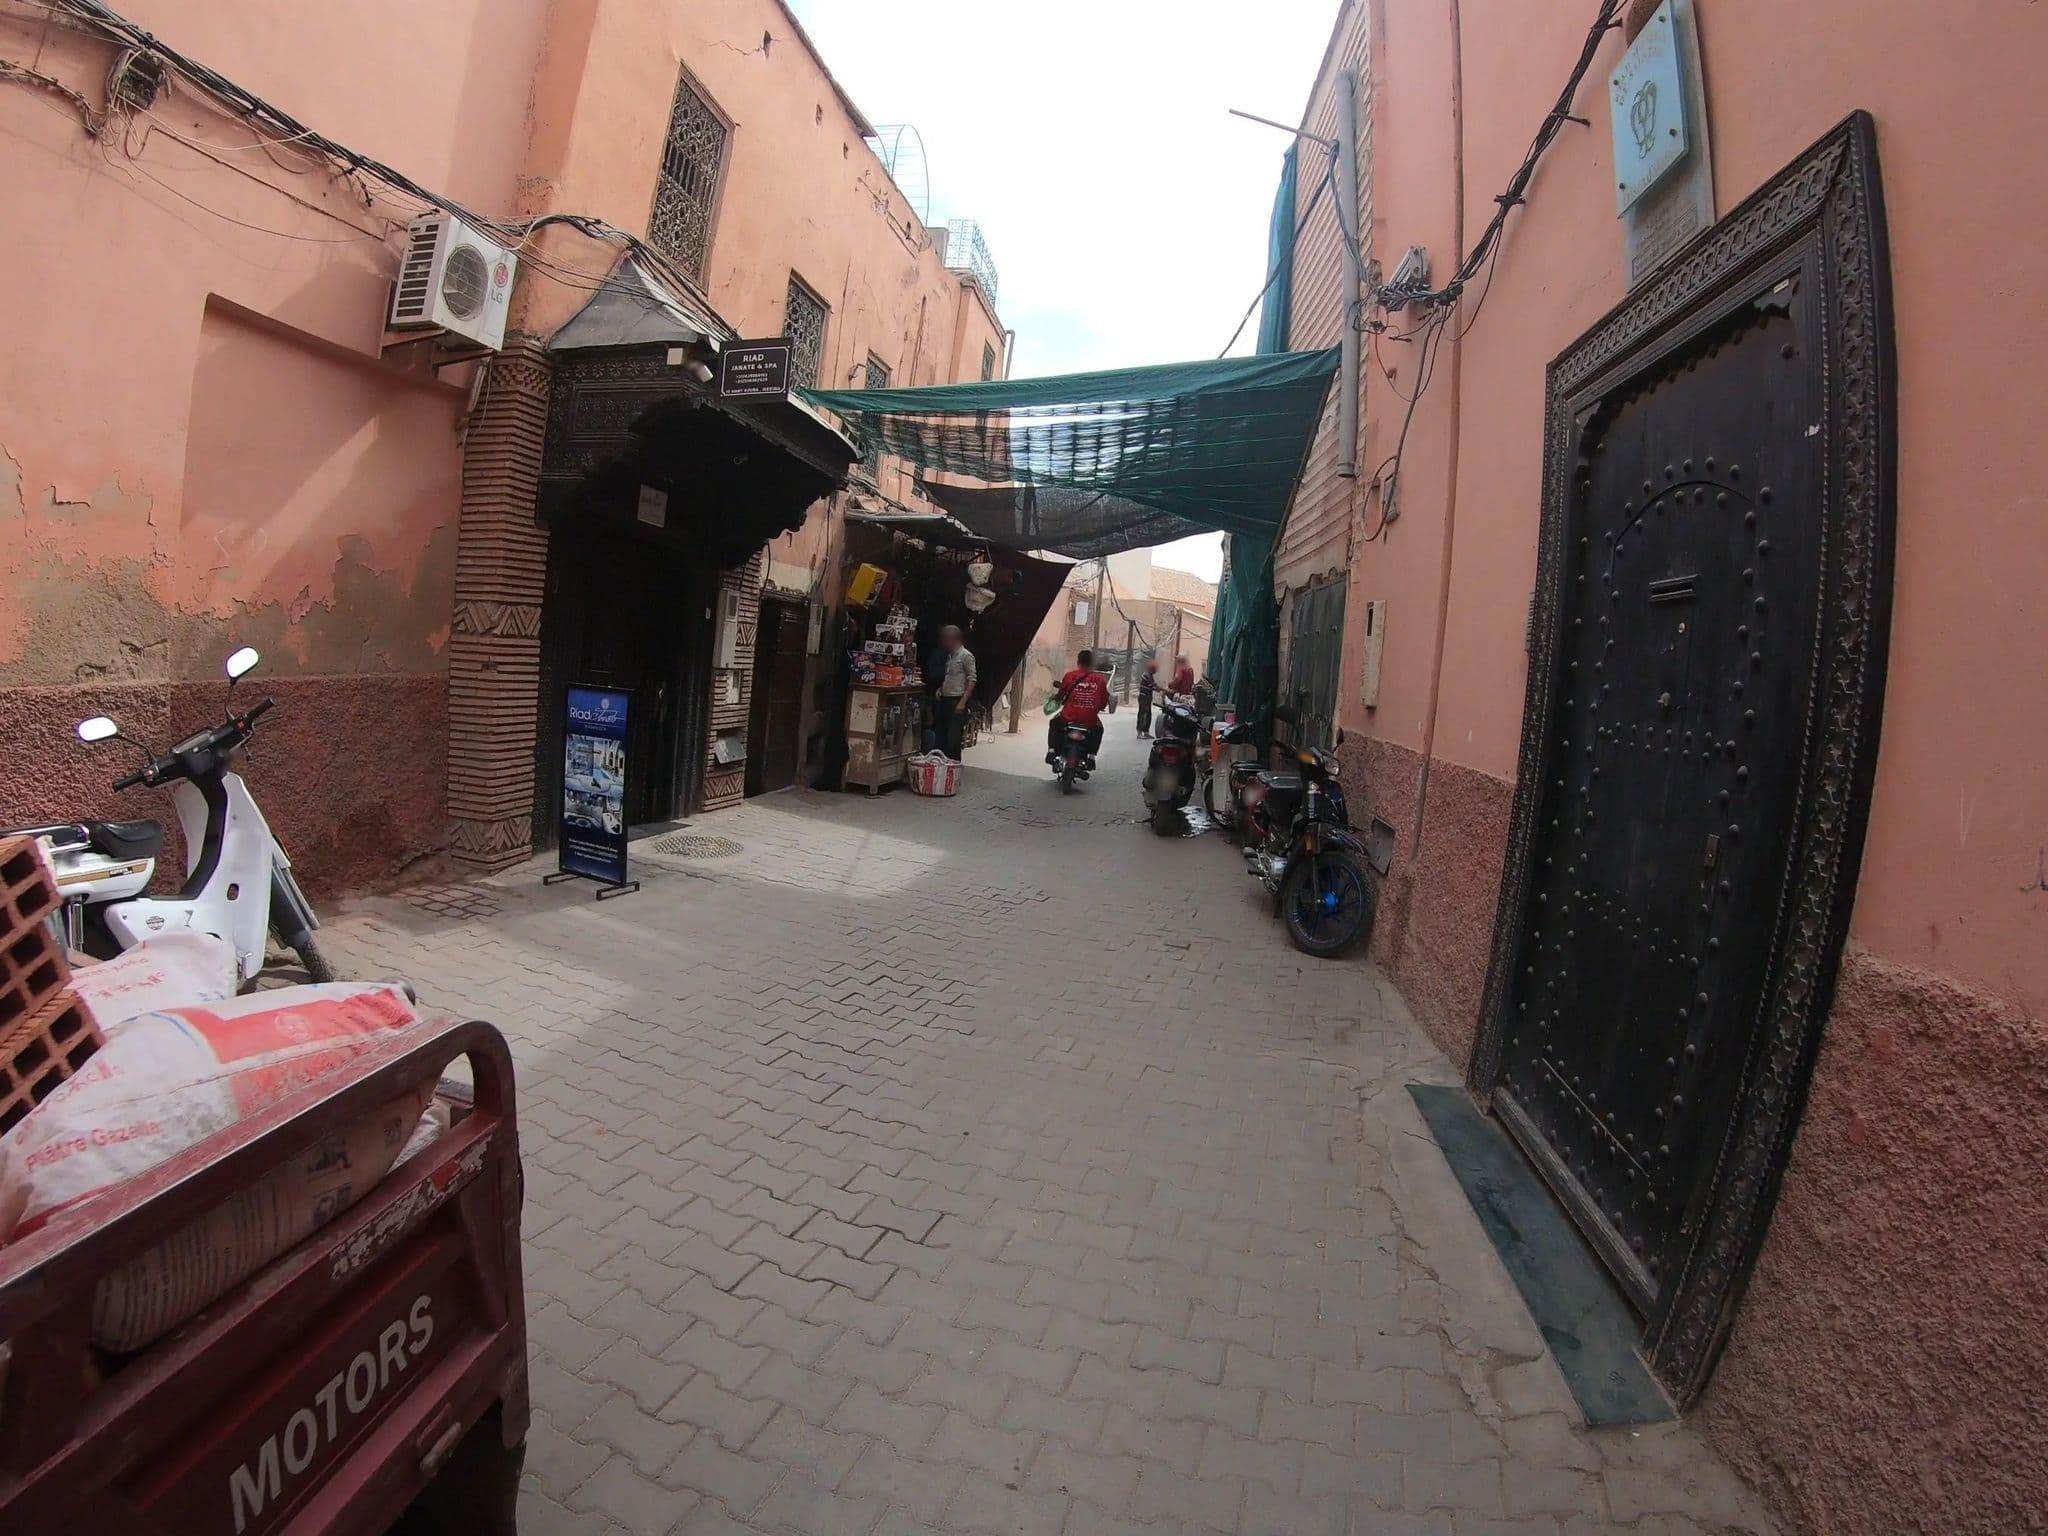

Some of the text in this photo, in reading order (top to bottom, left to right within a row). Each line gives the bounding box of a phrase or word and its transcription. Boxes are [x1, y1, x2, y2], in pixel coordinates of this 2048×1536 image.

[491, 289, 503, 304] LG
[742, 354, 764, 362] RIAD
[731, 363, 755, 371] JANATE
[569, 706, 591, 720] Riad
[229, 1295, 434, 1535] MOTORS
